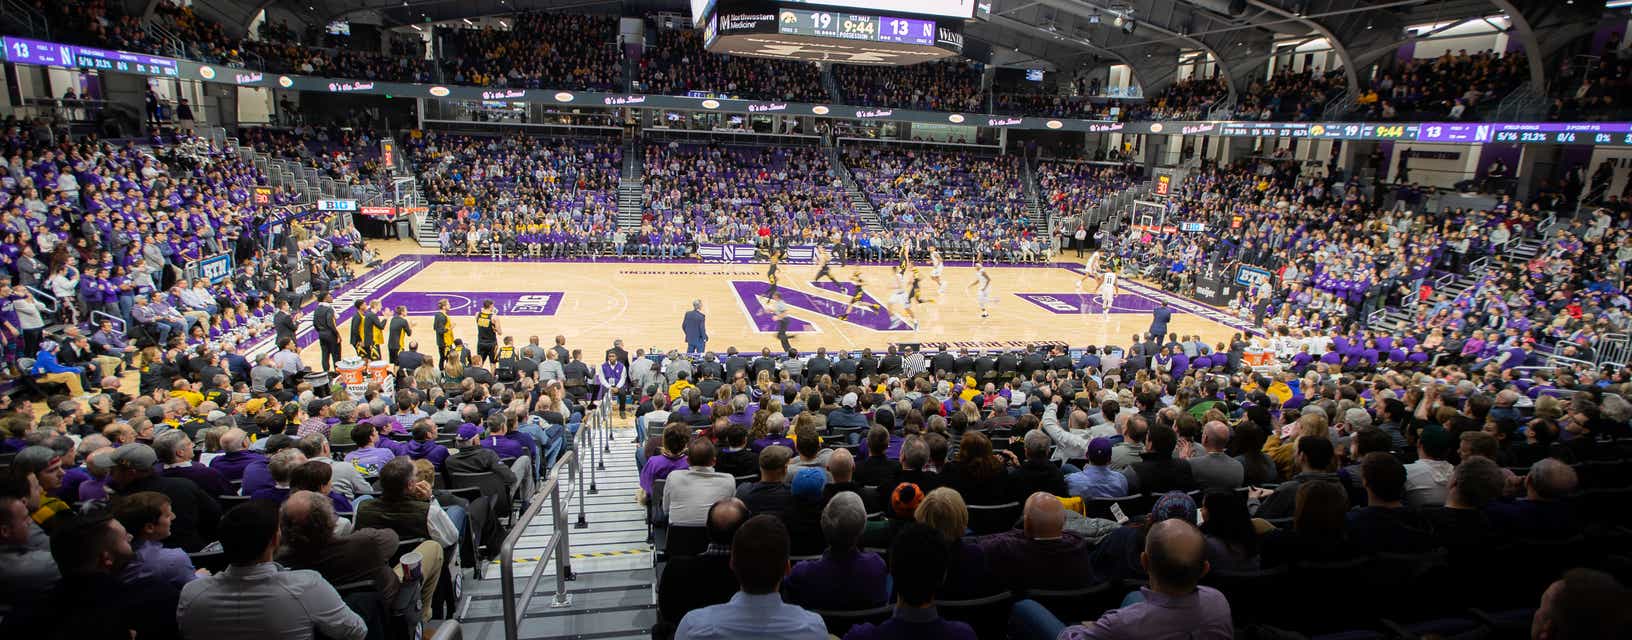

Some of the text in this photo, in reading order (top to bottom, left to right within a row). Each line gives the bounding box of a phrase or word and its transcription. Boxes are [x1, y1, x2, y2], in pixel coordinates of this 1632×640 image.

[730, 12, 775, 21] Northwestern
[810, 12, 830, 28] 19
[730, 21, 756, 29] Medicine
[844, 20, 874, 34] 9:44
[890, 20, 909, 36] 13
[923, 23, 932, 36] N
[13, 42, 29, 58] 13
[60, 46, 72, 65] N
[1344, 125, 1359, 136] 19
[1376, 126, 1404, 137] 9:44
[1426, 126, 1442, 138] 13
[1475, 125, 1489, 141] N
[1496, 132, 1547, 142] 5/16 31.3%
[1556, 132, 1611, 143] 0/6 0%
[1157, 182, 1168, 194] 30
[723, 245, 734, 261] N
[203, 258, 228, 278] BTN
